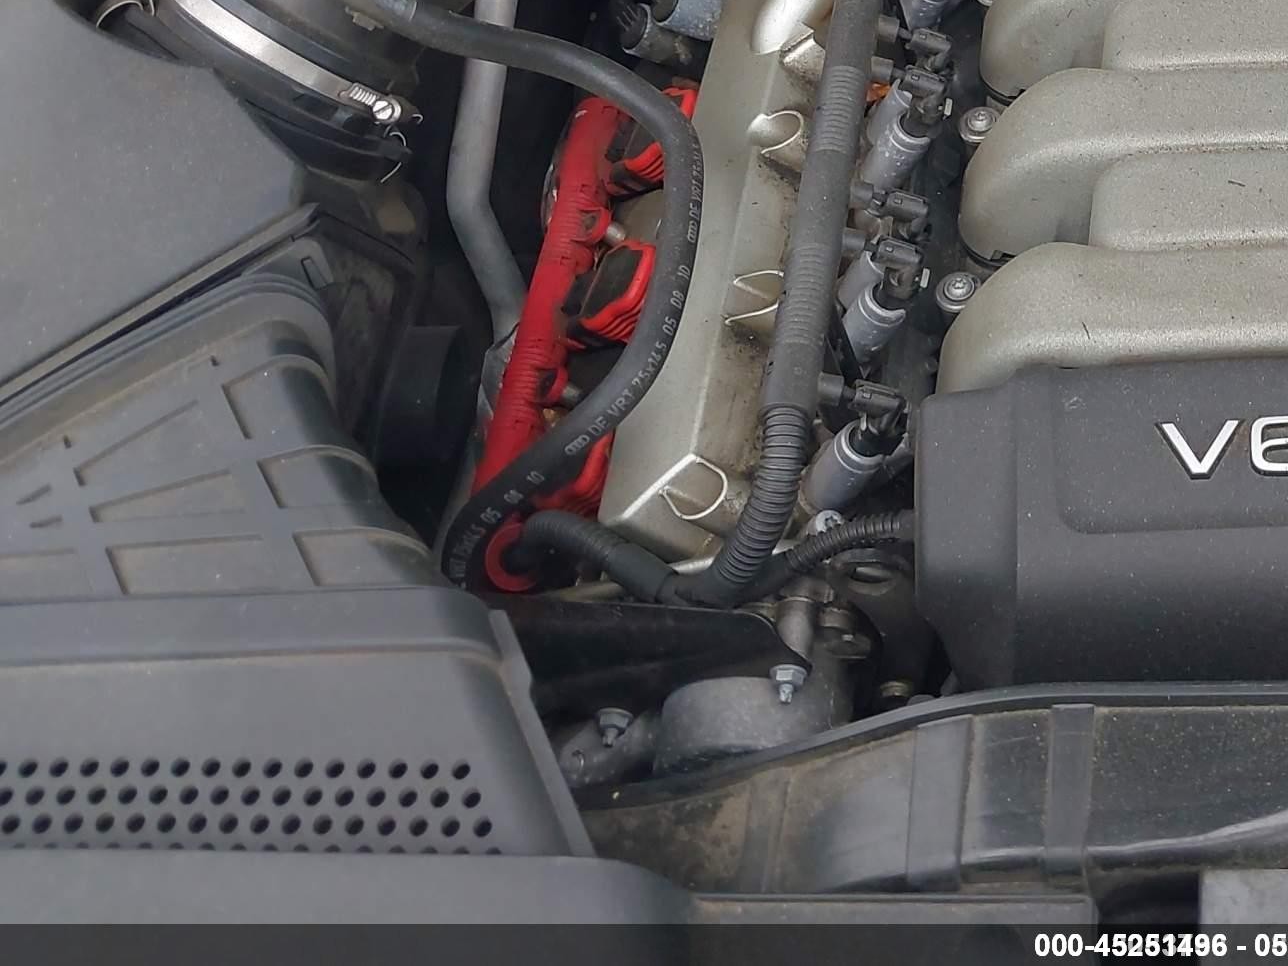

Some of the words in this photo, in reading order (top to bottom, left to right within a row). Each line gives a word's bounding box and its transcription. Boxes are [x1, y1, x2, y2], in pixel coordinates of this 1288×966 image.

[677, 264, 692, 280] 10
[670, 289, 686, 310] 08
[662, 315, 678, 337] 05
[606, 387, 636, 419] VRT
